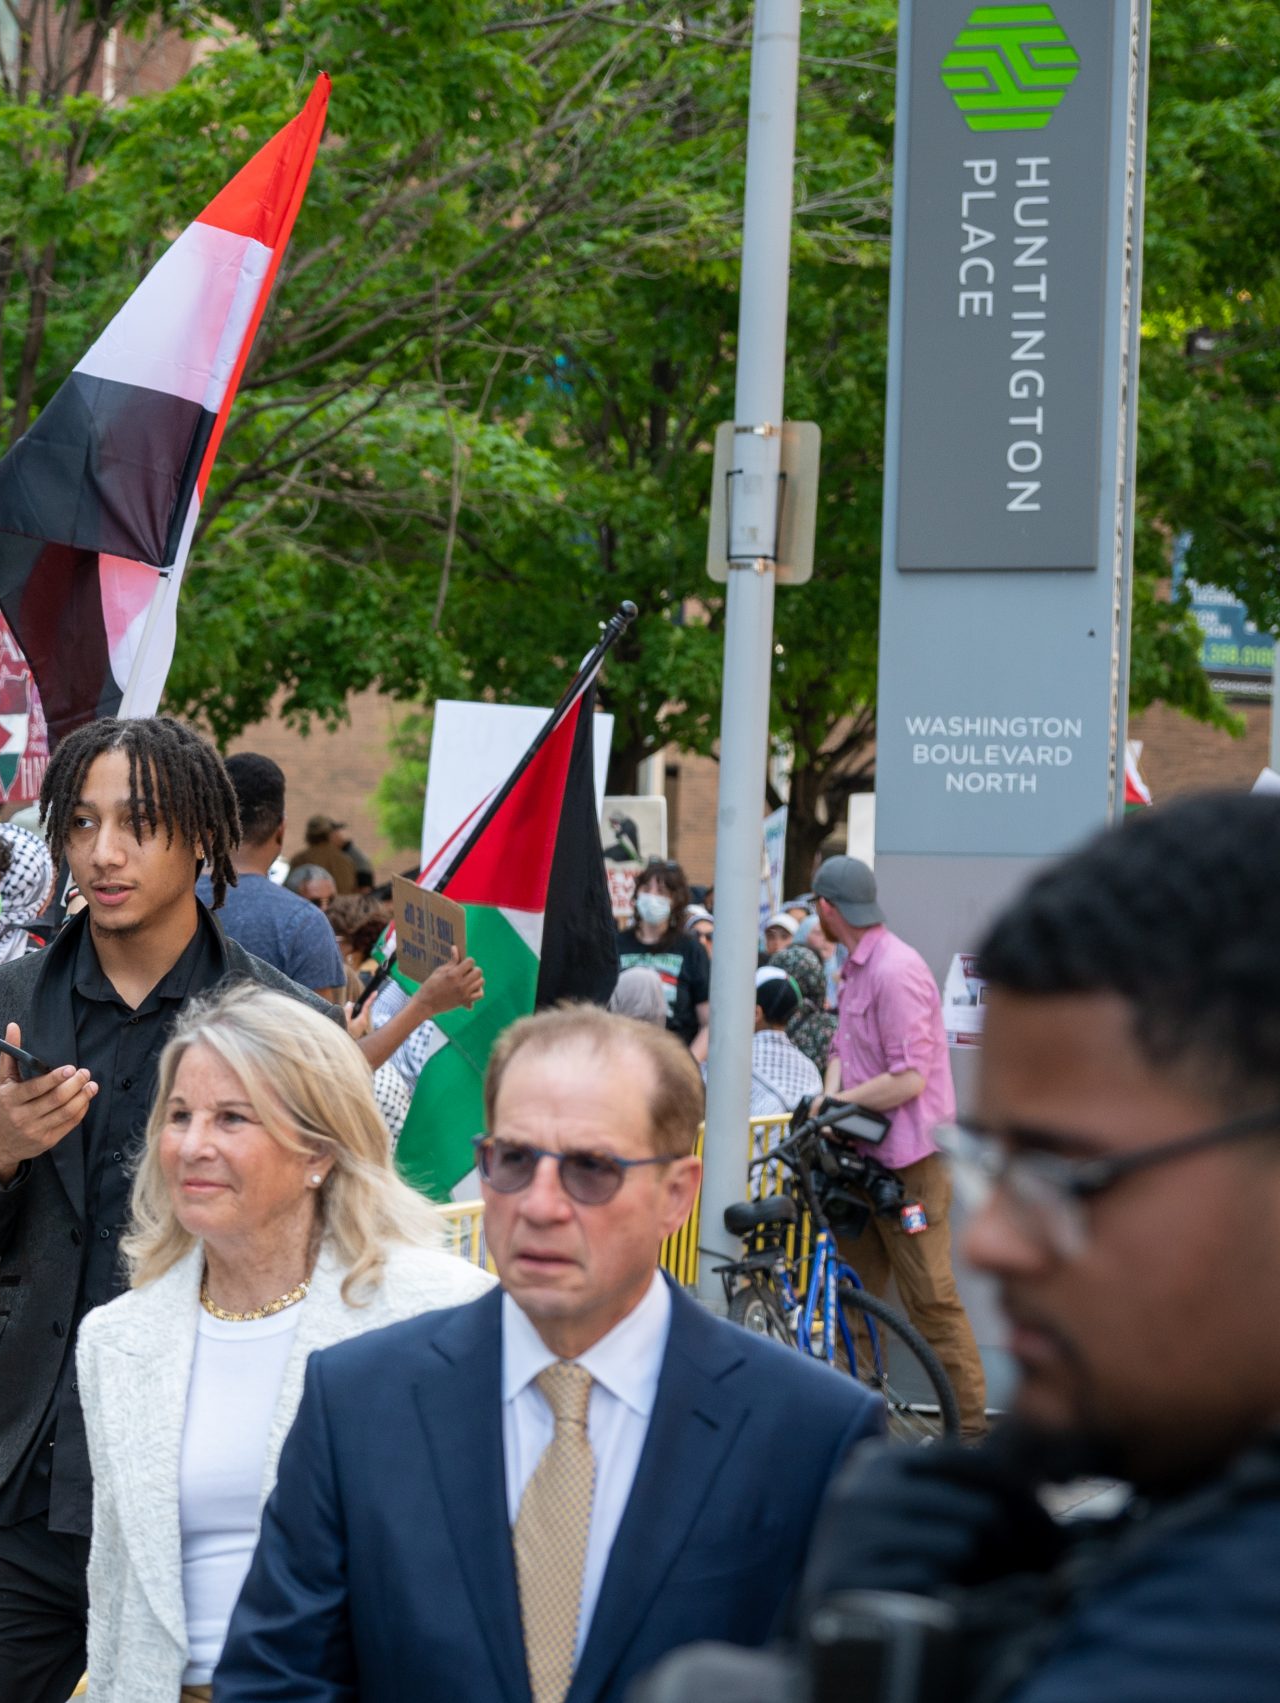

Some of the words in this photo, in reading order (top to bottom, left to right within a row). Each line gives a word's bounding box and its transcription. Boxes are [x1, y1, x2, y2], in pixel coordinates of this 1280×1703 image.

[958, 159, 997, 318] PLACE
[1006, 157, 1051, 512] HUNTINGTON
[904, 715, 1083, 739] WASHINGTON
[912, 743, 1073, 767] BOULEVARD
[945, 771, 1038, 794] NORTH
